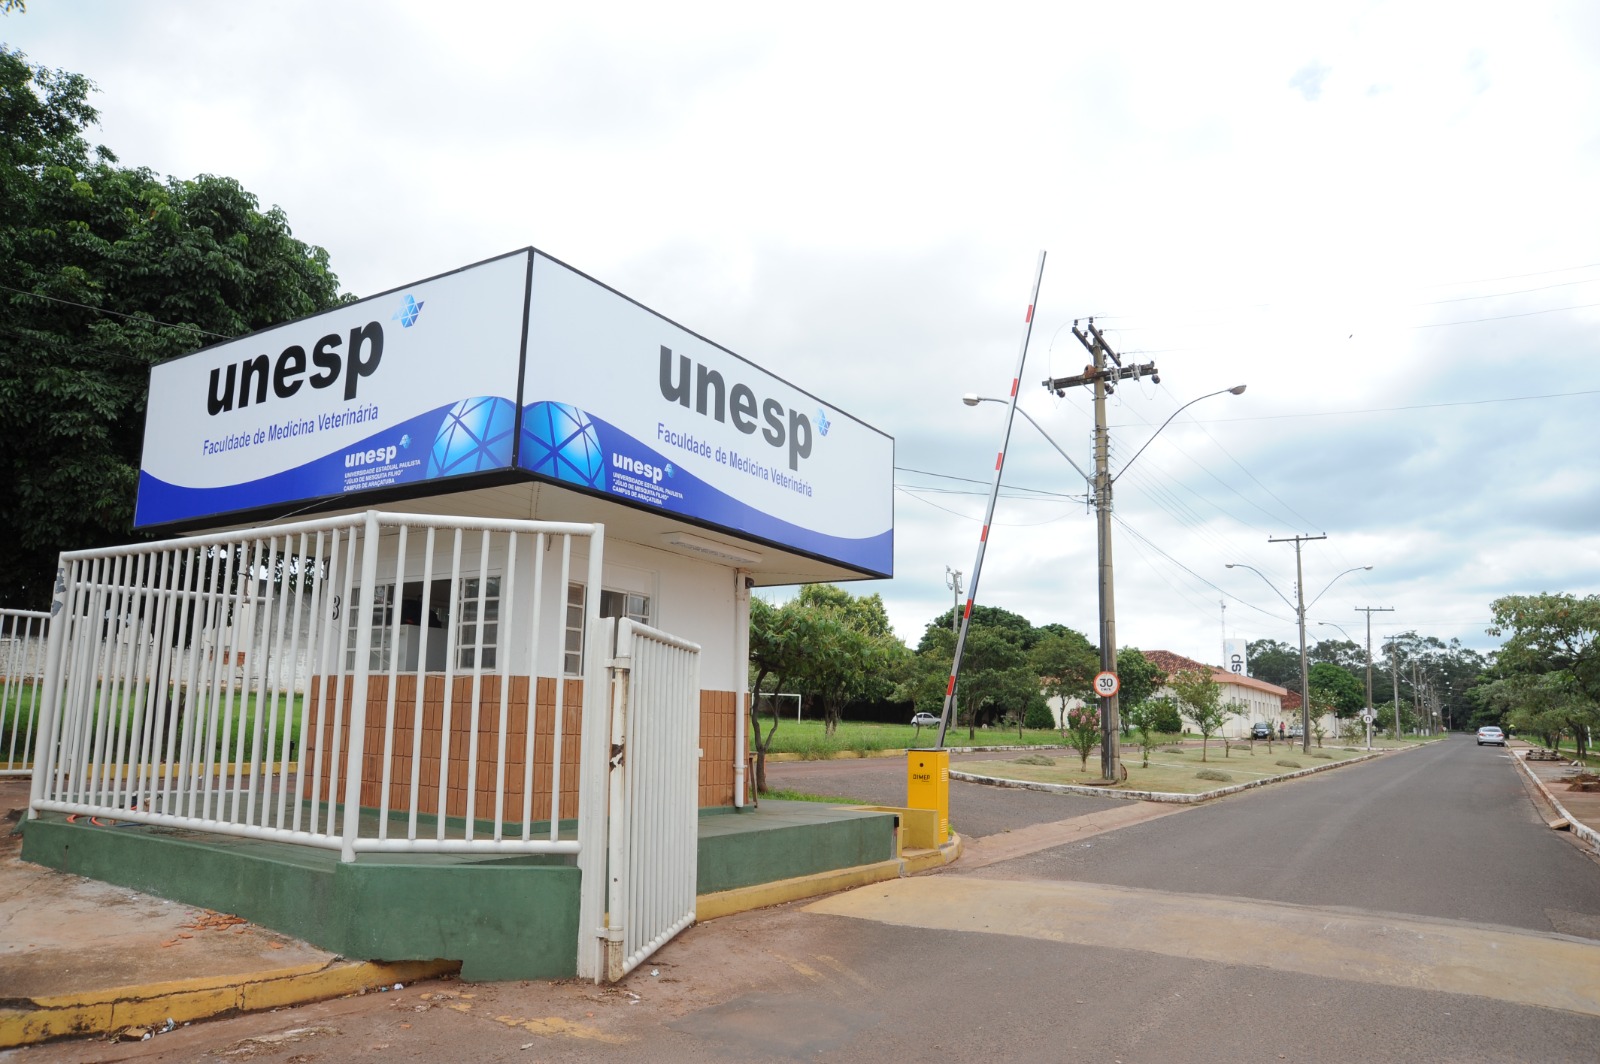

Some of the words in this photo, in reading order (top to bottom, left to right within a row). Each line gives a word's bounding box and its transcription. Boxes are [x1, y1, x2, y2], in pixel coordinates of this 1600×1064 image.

[207, 321, 384, 416] unesp
[659, 344, 812, 472] unesp
[203, 431, 250, 455] Faculdade
[253, 428, 266, 445] de
[268, 418, 314, 442] Medicina
[318, 403, 378, 430] Veterinária
[344, 445, 397, 468] unesp
[658, 422, 712, 458] Faculdade
[716, 446, 726, 464] de
[730, 450, 768, 480] Medicina
[770, 467, 812, 497] Veterinária
[344, 467, 376, 478] UNIVERSIDADE
[376, 464, 398, 473] ESTADUAL
[399, 460, 421, 468] PAULISTA
[366, 472, 387, 481] MESQUITA
[612, 452, 663, 484] unesp
[344, 482, 362, 491] CAMPUS
[612, 472, 644, 486] UNIVERSIDADE
[644, 482, 664, 493] ESTADUAL
[612, 485, 630, 496] CAMPUS
[635, 485, 656, 496] MESQUITA
[1231, 654, 1243, 675] sp
[1100, 678, 1113, 687] 30
